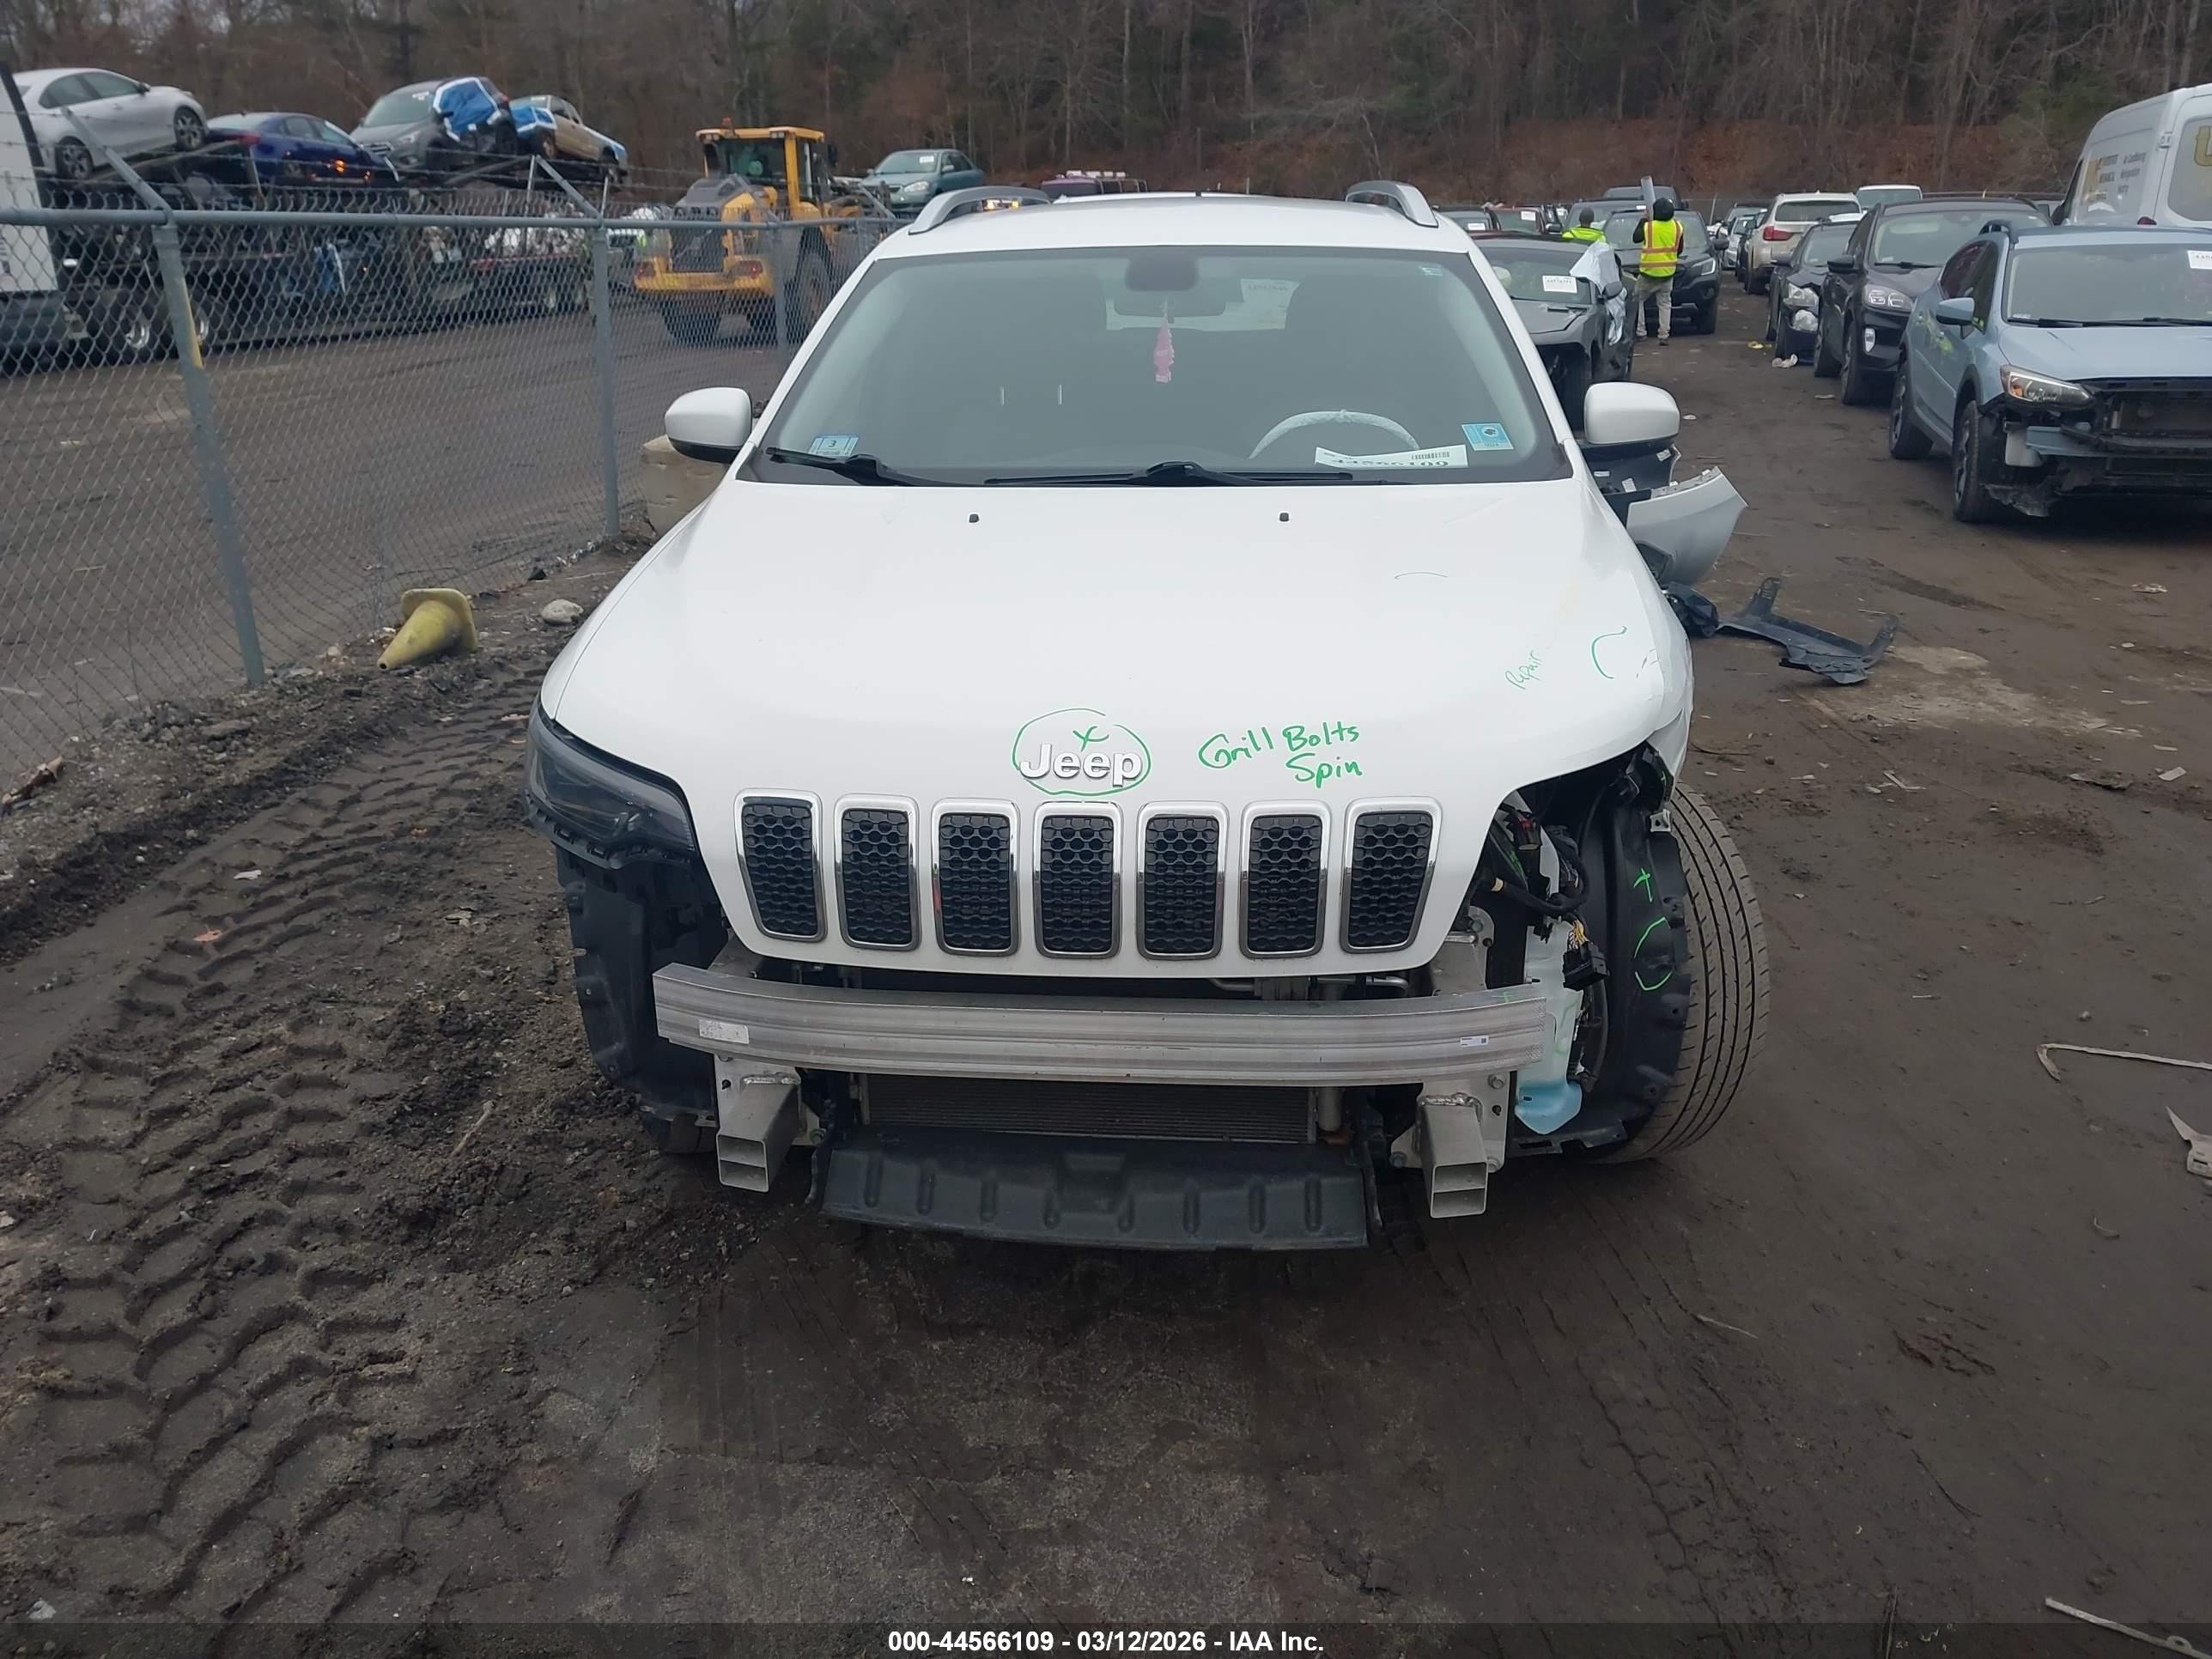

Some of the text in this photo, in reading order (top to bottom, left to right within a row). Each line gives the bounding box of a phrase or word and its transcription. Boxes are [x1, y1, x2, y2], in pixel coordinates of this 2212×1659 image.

[1019, 743, 1143, 787] Jeep
[1198, 720, 1360, 769] Grill Bolts
[1285, 752, 1363, 789] Spin
